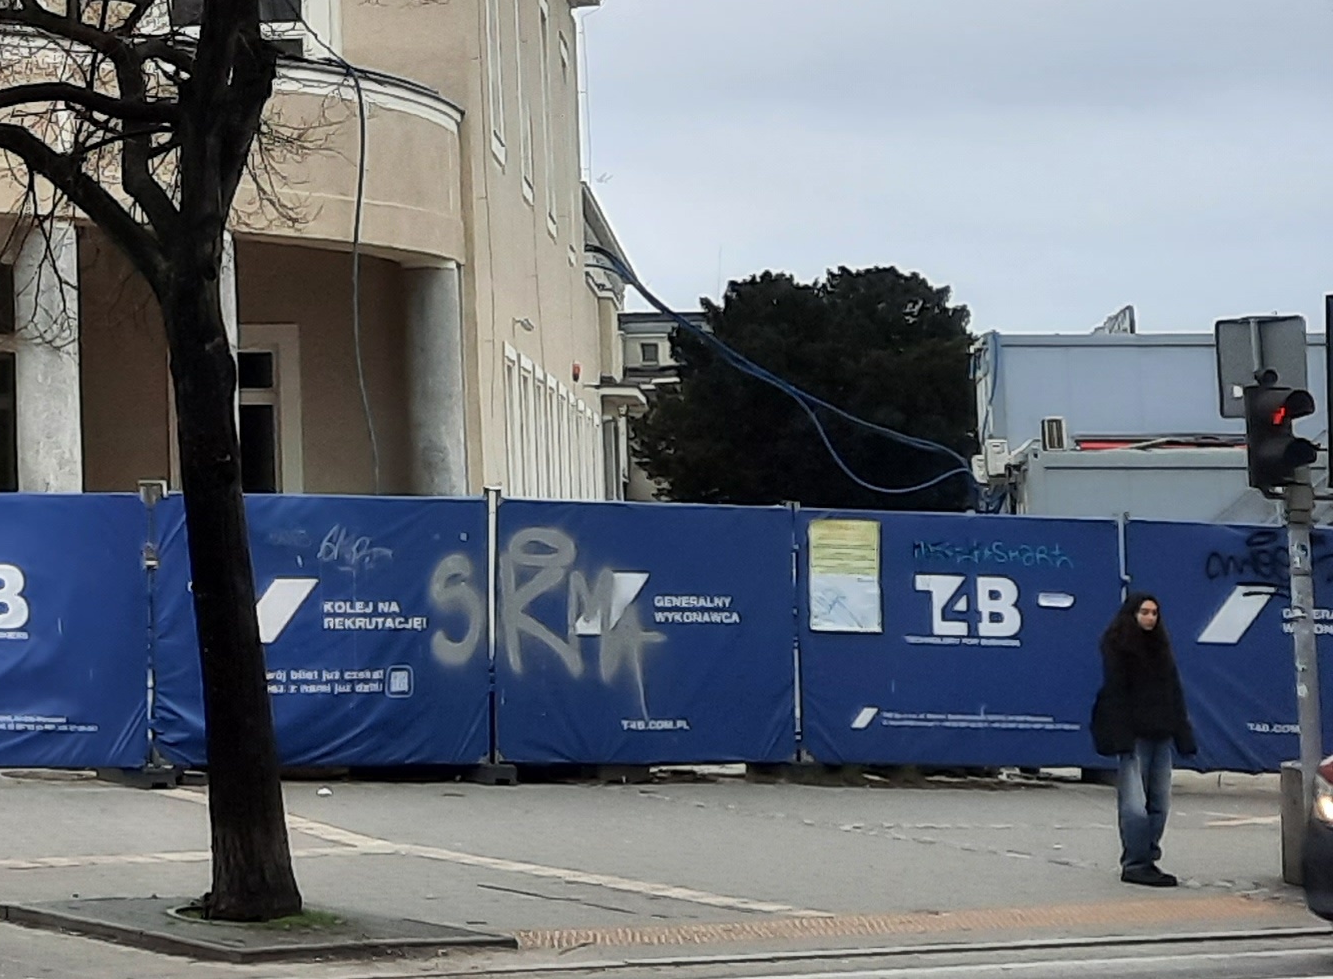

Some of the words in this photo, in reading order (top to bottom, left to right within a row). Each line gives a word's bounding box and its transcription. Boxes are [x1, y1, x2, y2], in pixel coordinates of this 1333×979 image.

[323, 601, 373, 613] KOLEJ
[378, 601, 400, 613] NA
[653, 595, 732, 609] GENERALNY
[914, 574, 1022, 637] T4B
[653, 611, 740, 624] WYKONAWCA
